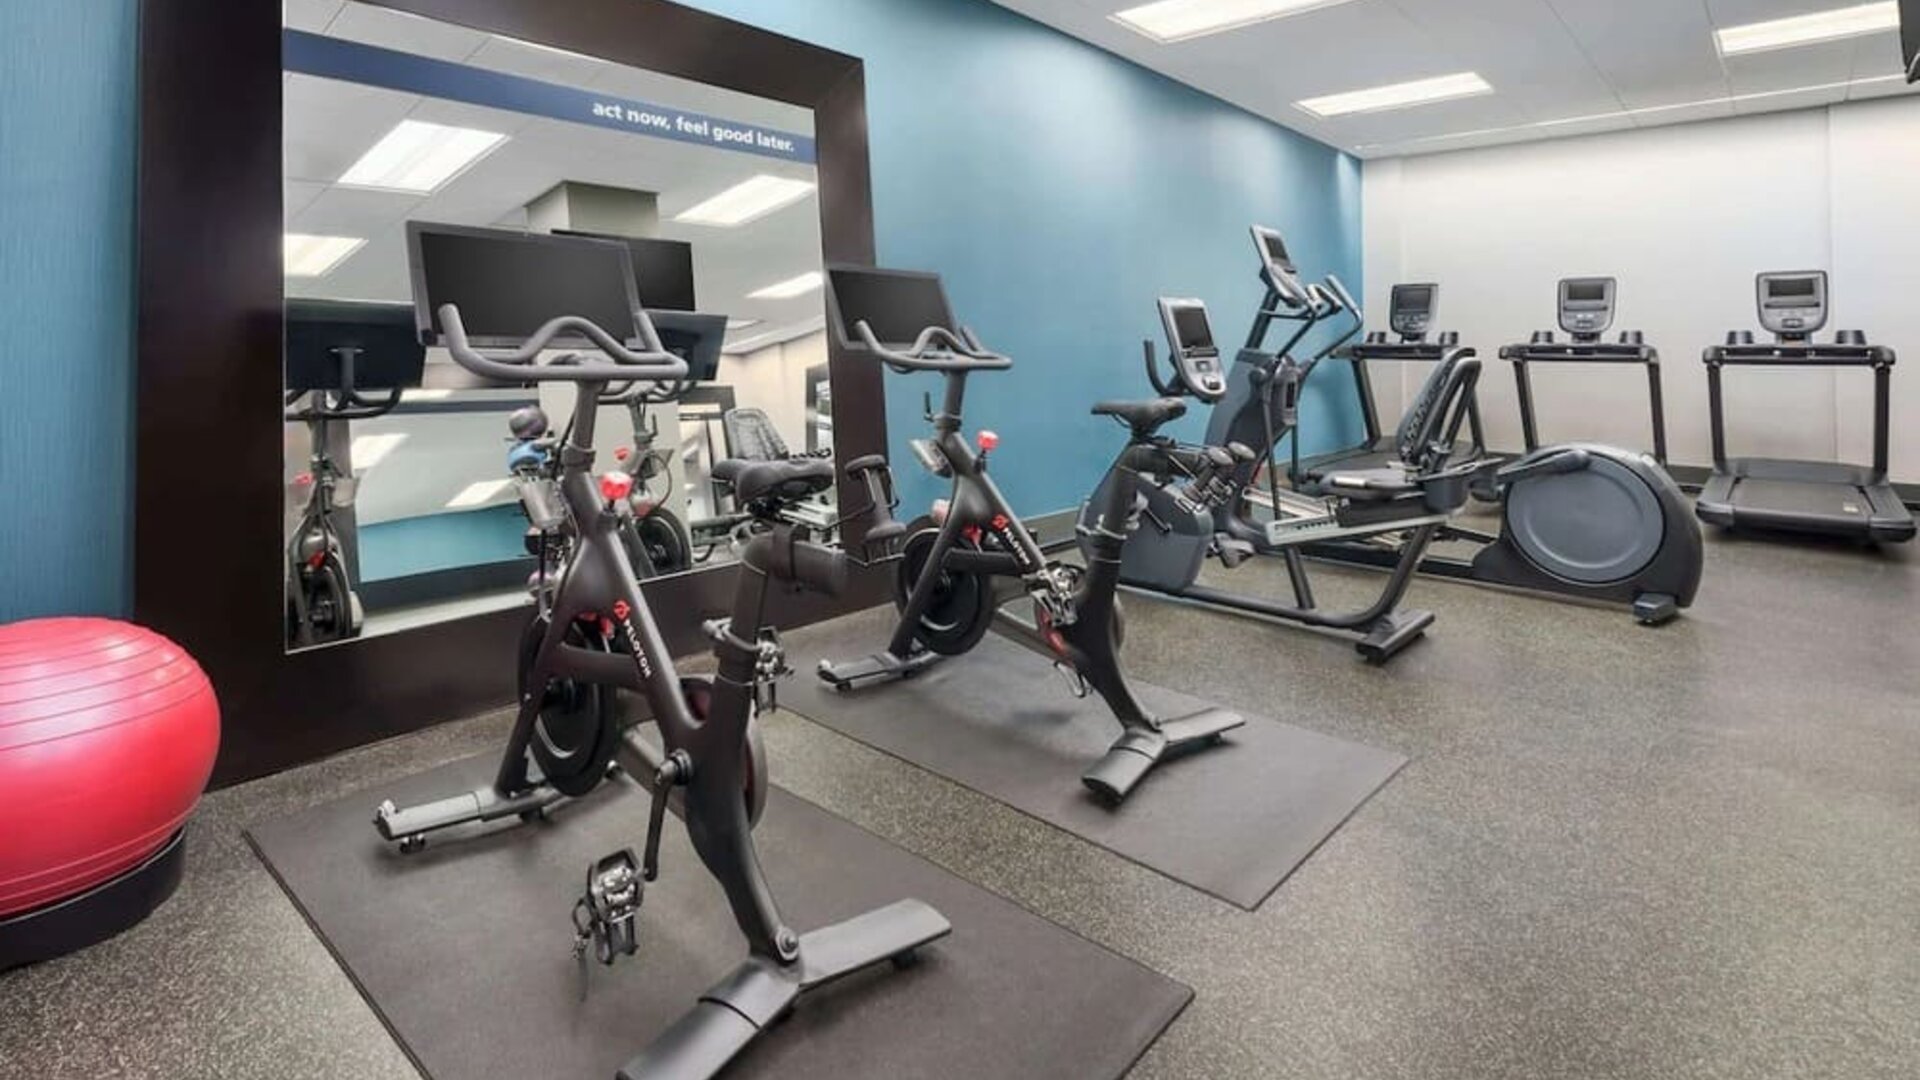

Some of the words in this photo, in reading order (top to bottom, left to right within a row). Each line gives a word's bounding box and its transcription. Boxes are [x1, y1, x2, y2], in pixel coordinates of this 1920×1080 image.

[592, 103, 622, 120] act
[627, 109, 671, 130] now,
[675, 116, 709, 136] feel
[713, 127, 753, 144] good
[757, 132, 794, 152] later.
